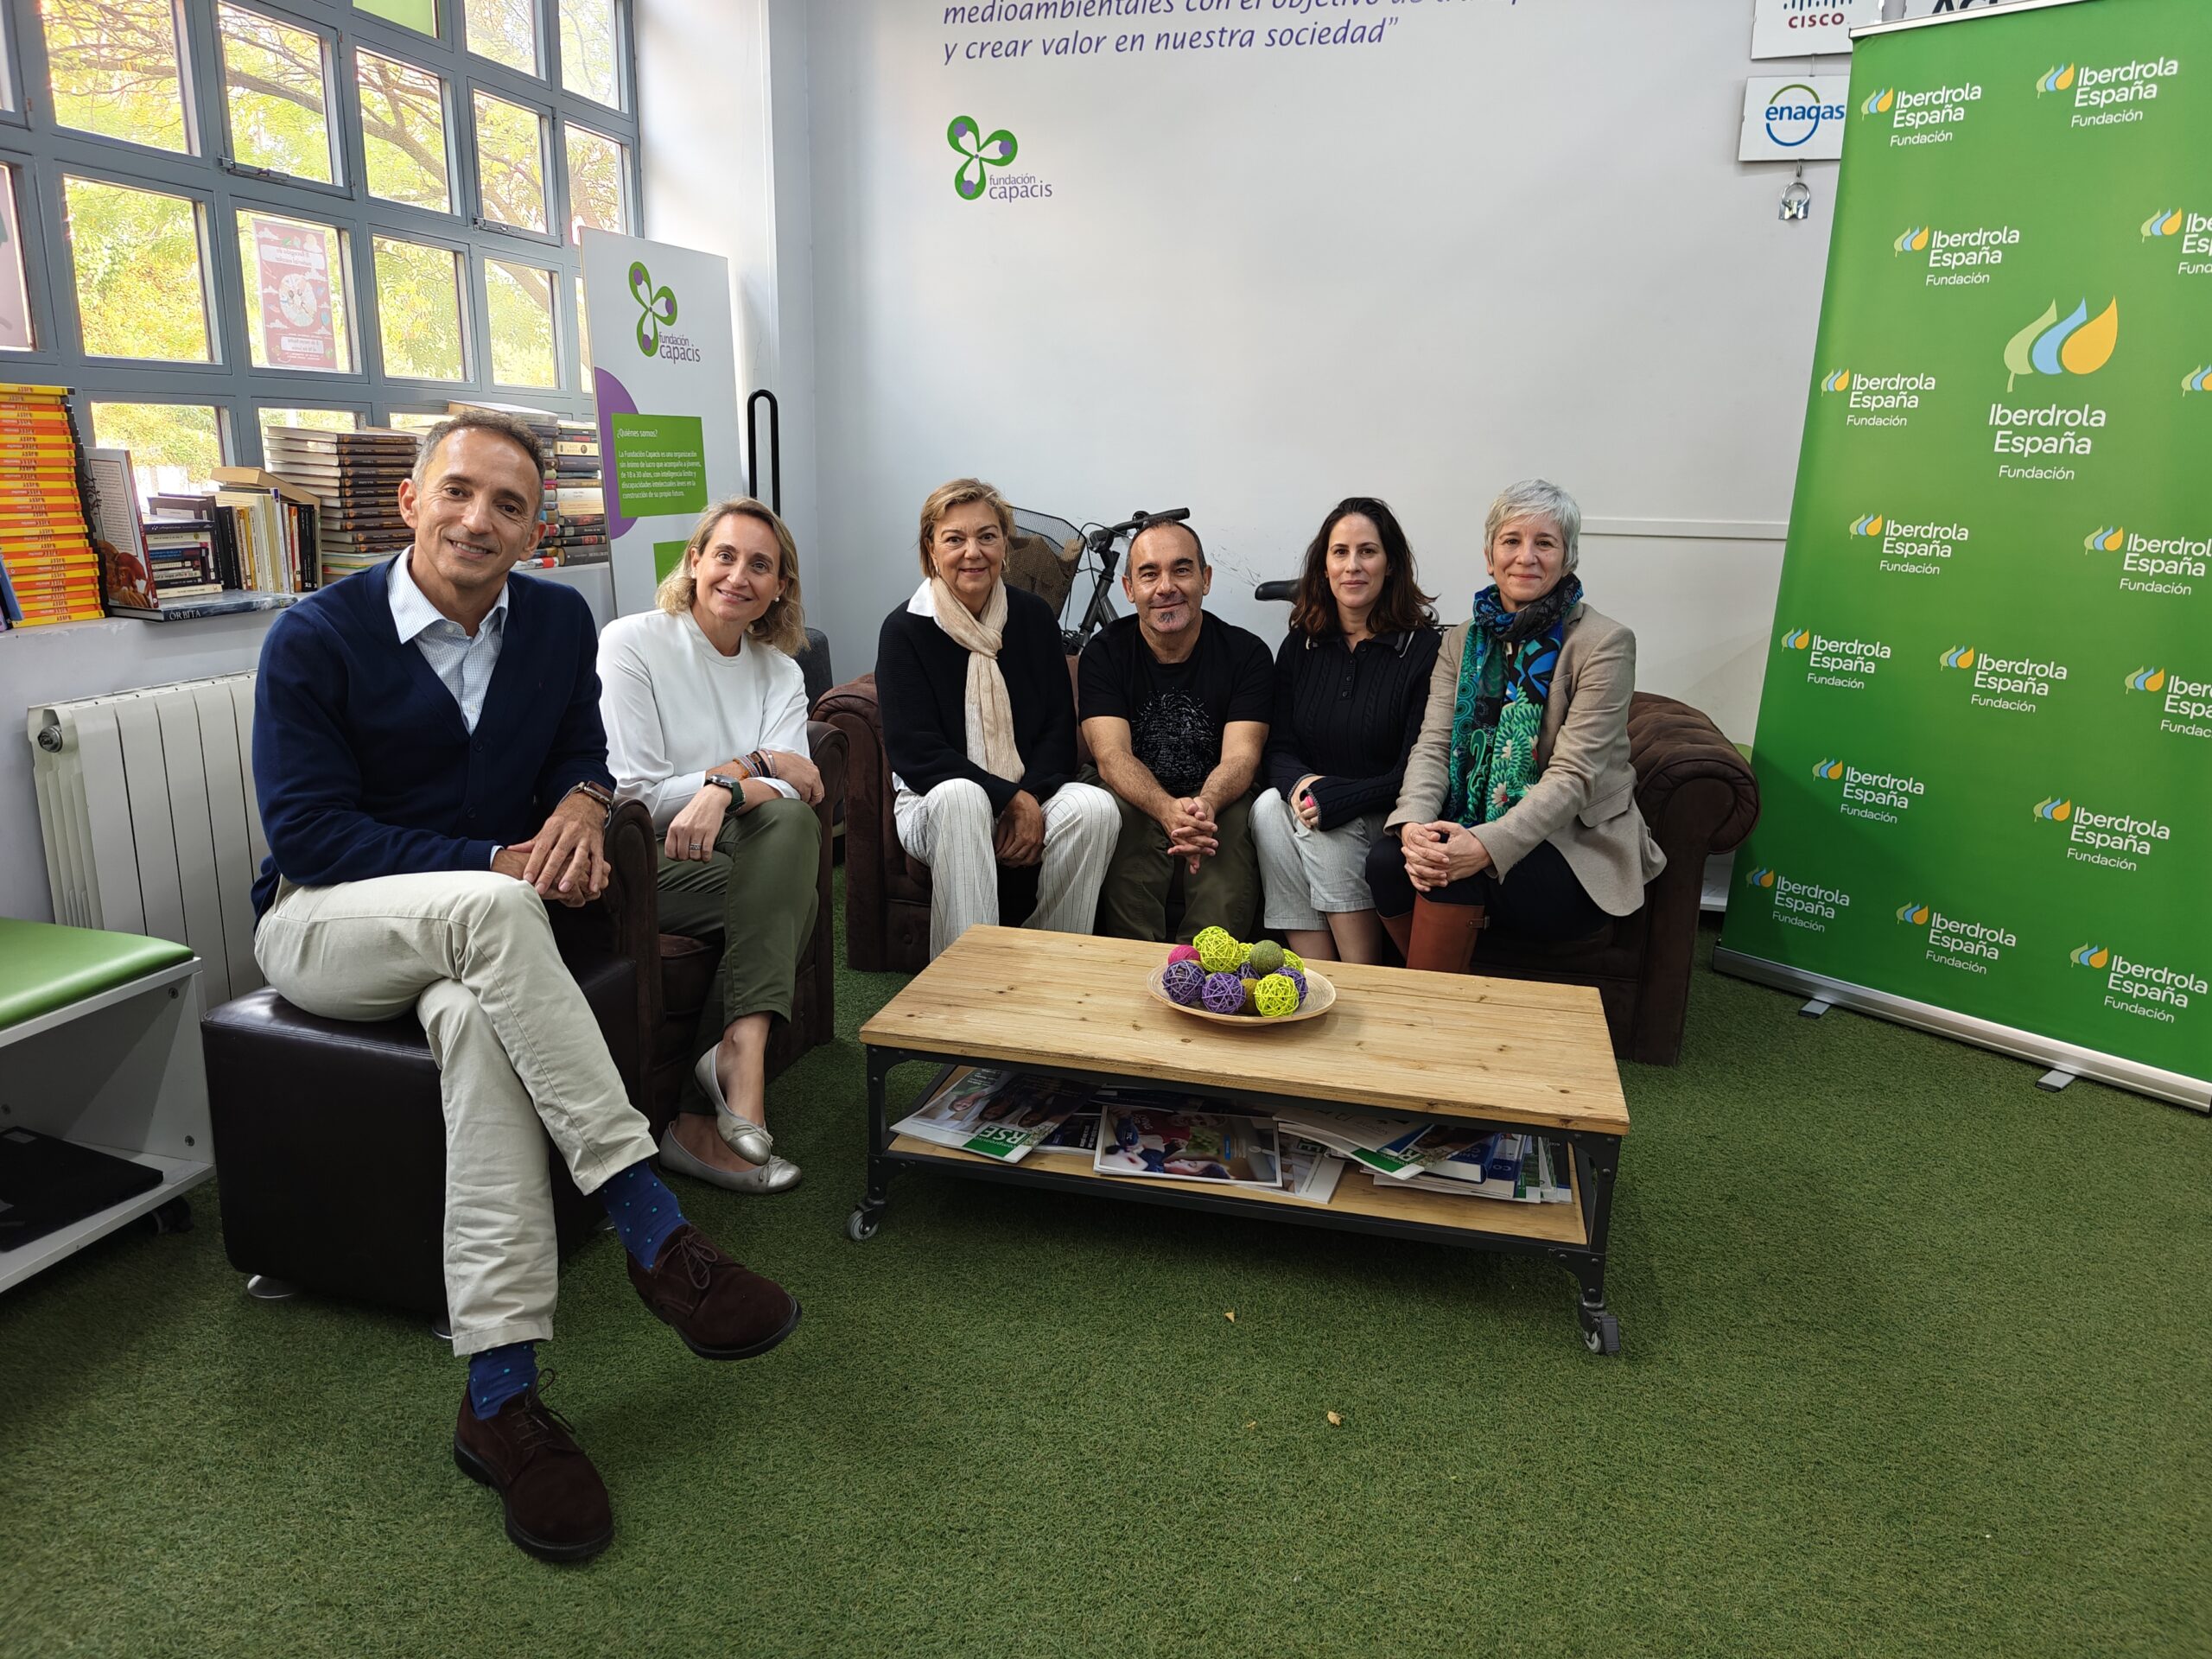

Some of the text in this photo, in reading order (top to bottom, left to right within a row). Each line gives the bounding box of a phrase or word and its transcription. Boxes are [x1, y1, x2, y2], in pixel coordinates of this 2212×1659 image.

[943, 0, 1175, 24] medioambientales
[1788, 12, 1845, 29] CISCO
[944, 41, 958, 66] y
[965, 38, 1033, 60] crear
[1042, 30, 1108, 55] valor
[1115, 34, 1145, 52] en
[1155, 27, 1255, 50] nuestra
[2078, 57, 2178, 87] Iberdrola
[1896, 83, 1981, 109] Iberdrola
[2074, 82, 2158, 109] España
[1765, 104, 1846, 123] enagas
[1893, 105, 1965, 129] España
[2071, 109, 2143, 128] Fundación
[1890, 130, 1953, 147] Fundación
[989, 172, 1036, 185] fundación
[988, 181, 1053, 203] capacis
[1931, 226, 2020, 250] Iberdrola
[1929, 247, 2002, 269] España
[1926, 272, 1989, 285] Fundación
[659, 332, 690, 346] fundación
[659, 344, 701, 365] capacis
[1853, 373, 1936, 391] Iberdrola
[1849, 391, 1919, 411] España
[1847, 415, 1907, 427] Fundación
[1989, 404, 2106, 428] Iberdrola
[640, 429, 658, 437] somos?
[1994, 430, 2092, 458] España
[1999, 465, 2075, 480] Fundación
[1885, 519, 1969, 541] Iberdrola
[1883, 537, 1952, 558] España
[1879, 560, 1940, 575] Fundación
[2123, 553, 2205, 577] España
[2120, 578, 2191, 595] Fundación
[1812, 634, 1891, 659] Iberdrola
[1809, 651, 1876, 675] España
[1977, 653, 2068, 681] Iberdrola
[1807, 672, 1865, 690] Fundación
[1974, 671, 2049, 697] España
[1971, 694, 2036, 713] Fundación
[1846, 766, 1925, 795] Iberdrola
[1842, 783, 1909, 810] España
[1840, 804, 1897, 824] Fundación
[2074, 807, 2171, 840] Iberdrola
[2070, 825, 2151, 855] España
[2067, 848, 2137, 872] Fundación
[1777, 875, 1850, 907] Iberdrola
[1774, 892, 1835, 920] España
[1772, 910, 1826, 933] Fundación
[1931, 912, 2017, 947] Iberdrola
[1928, 929, 1999, 961] España
[1925, 950, 1987, 976] Fundación
[2112, 955, 2209, 995] Iberdrola
[2107, 973, 2189, 1008] España
[2104, 995, 2175, 1024] Fundación
[979, 1126, 1027, 1144] RSE
